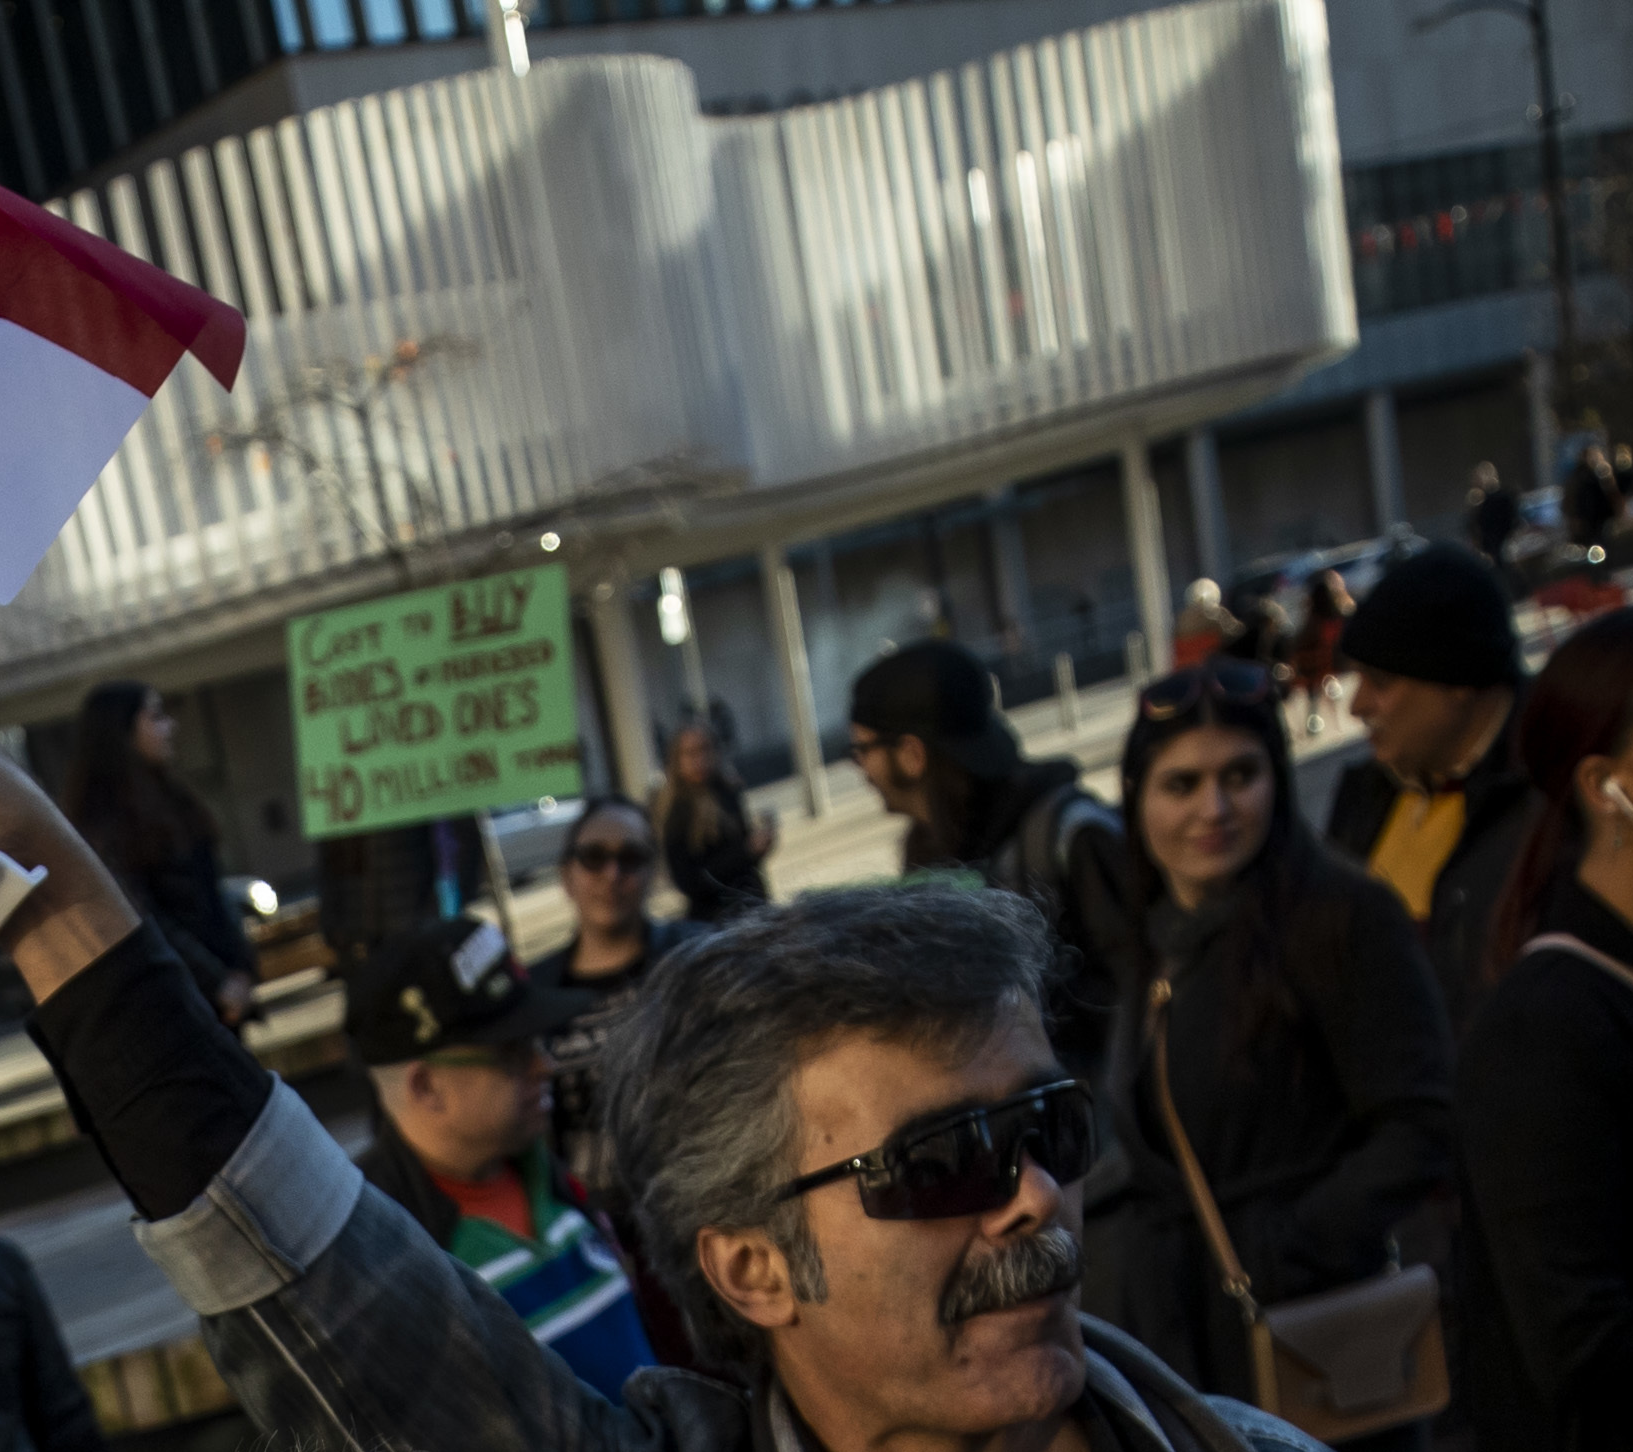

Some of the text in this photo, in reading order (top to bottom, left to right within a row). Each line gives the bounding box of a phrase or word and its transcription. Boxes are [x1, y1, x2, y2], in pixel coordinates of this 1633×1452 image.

[449, 576, 534, 634] BUY
[340, 677, 540, 755] LOVED ONES
[304, 764, 364, 822] 40
[370, 745, 499, 810] MILLION
